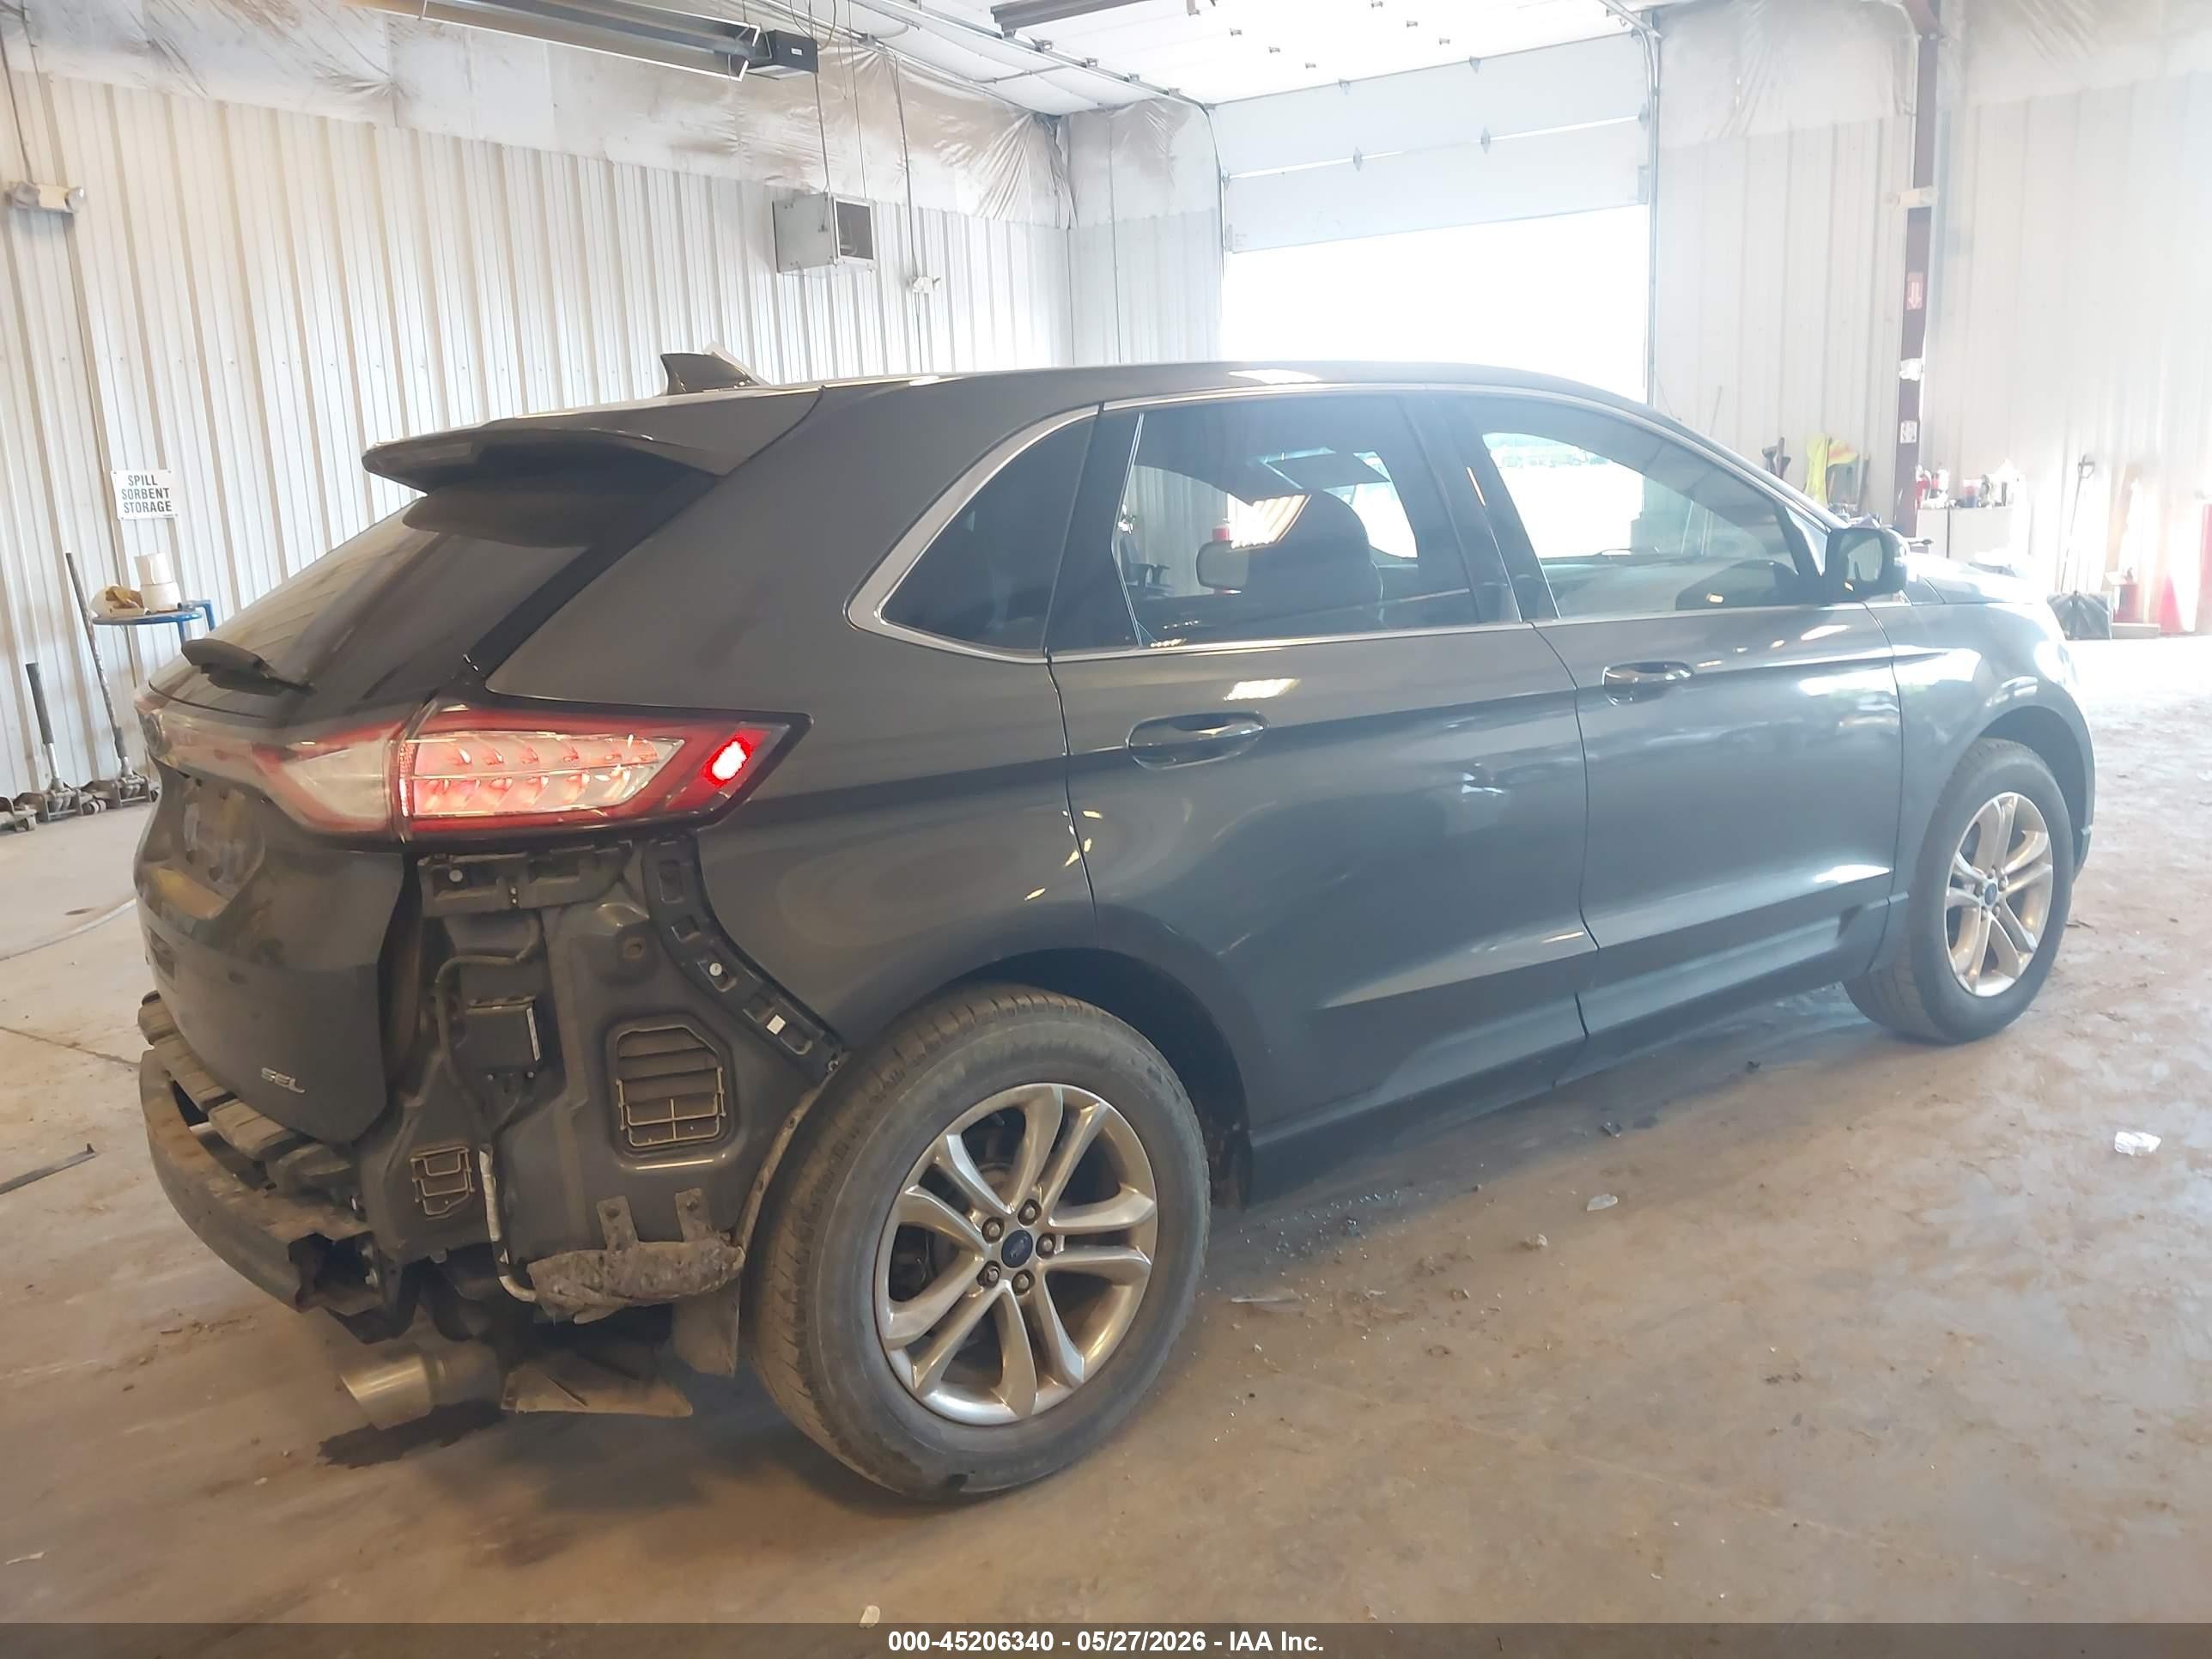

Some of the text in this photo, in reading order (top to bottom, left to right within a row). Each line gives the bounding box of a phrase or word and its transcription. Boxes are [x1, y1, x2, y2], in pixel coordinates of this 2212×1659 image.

[128, 474, 158, 486] SPILL
[121, 487, 170, 500] SORBENT
[124, 501, 173, 514] STORAGE
